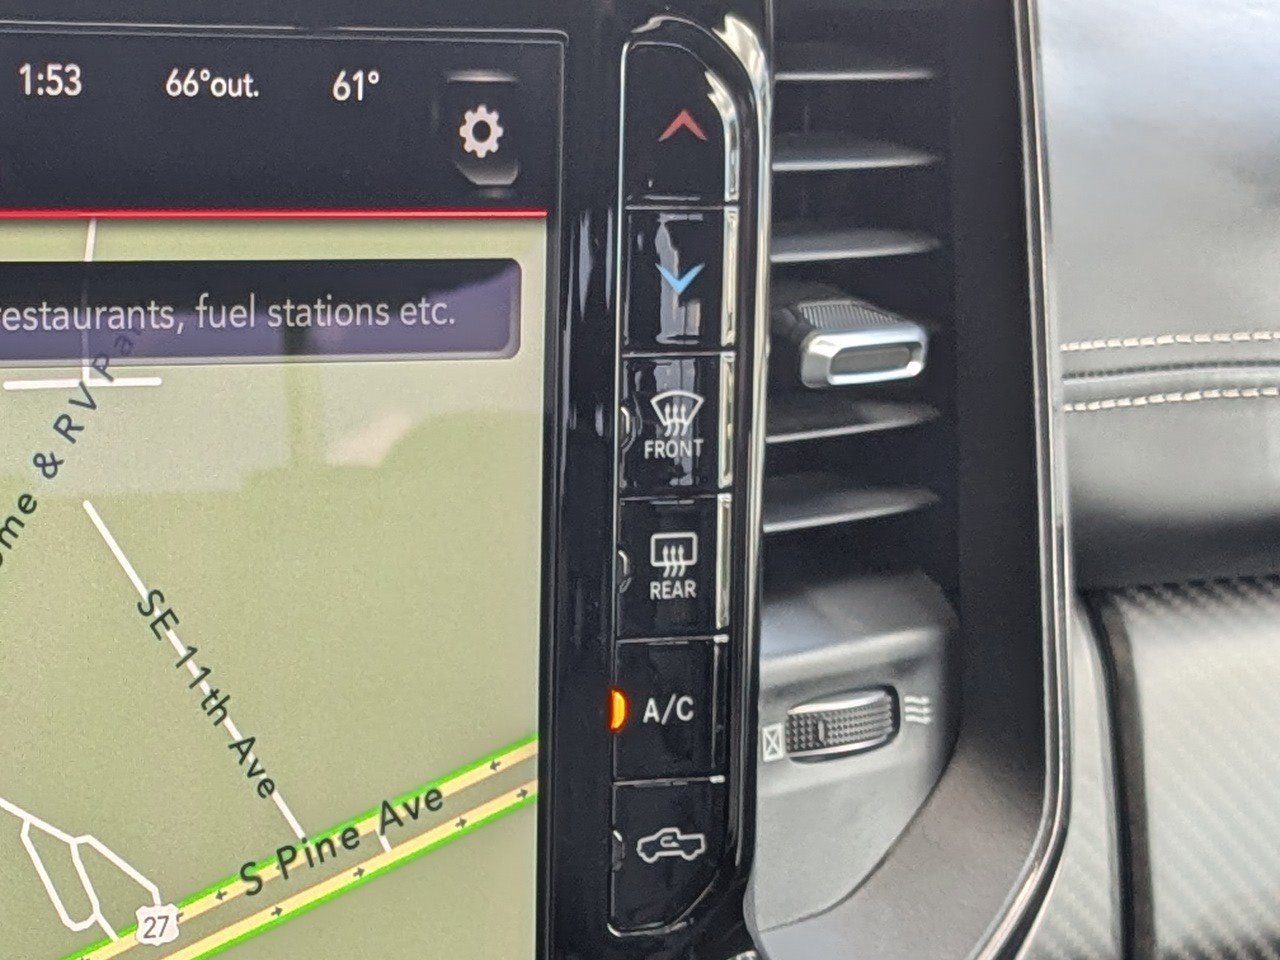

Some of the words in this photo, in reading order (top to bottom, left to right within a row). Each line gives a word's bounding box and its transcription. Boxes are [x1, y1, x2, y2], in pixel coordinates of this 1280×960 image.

[19, 63, 82, 96] 1:53
[333, 70, 380, 101] 61°
[196, 293, 256, 329] fuel
[268, 294, 389, 327] stations
[400, 297, 456, 326] etc.
[33, 452, 64, 479] &
[53, 381, 98, 444] RV
[644, 439, 704, 459] FRONT
[650, 580, 697, 600] REAR
[137, 589, 179, 641] SE
[175, 645, 231, 727] 11th
[228, 736, 276, 800] Ave
[642, 694, 694, 725] A/C
[239, 861, 264, 896] S
[276, 825, 360, 880] Pine
[379, 787, 444, 835] Ave
[143, 915, 170, 939] 27
